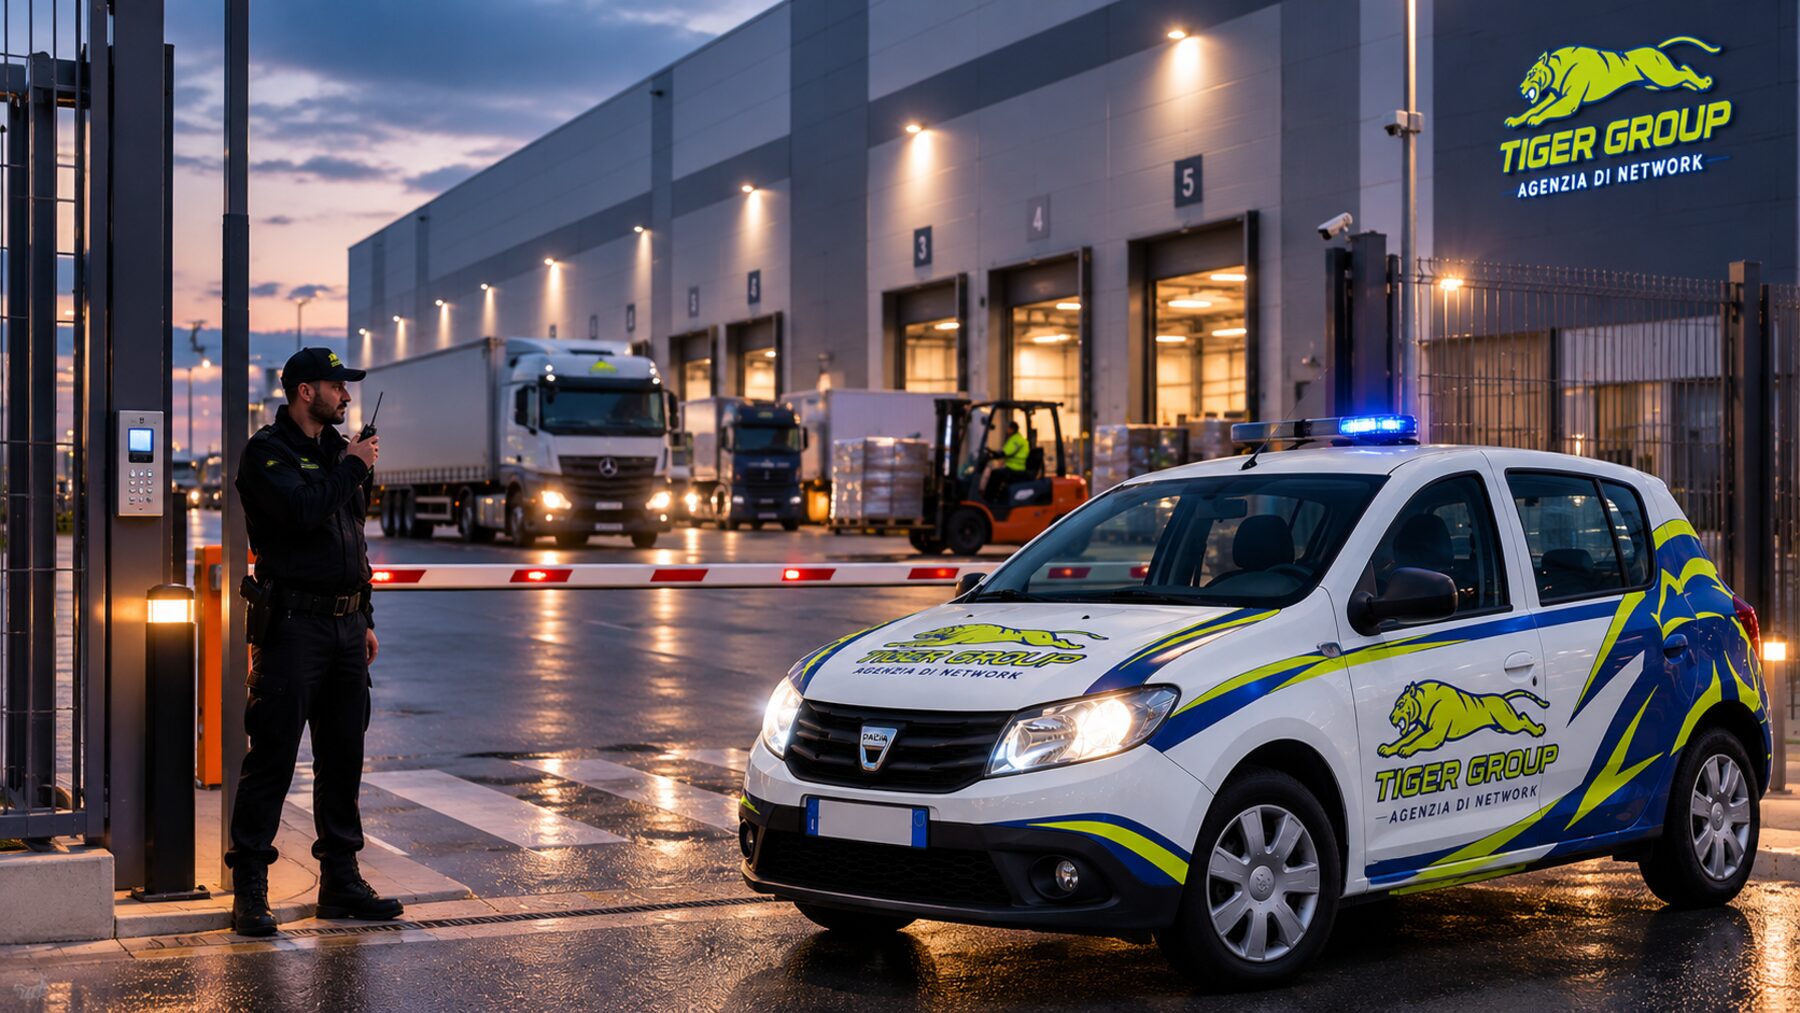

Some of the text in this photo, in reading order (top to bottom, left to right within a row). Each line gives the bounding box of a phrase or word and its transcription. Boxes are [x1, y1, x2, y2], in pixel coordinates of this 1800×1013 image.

[1500, 100, 1732, 173] TIGER GROUP
[1182, 168, 1194, 197] 5
[1517, 154, 1703, 198] AGENZIA DI NETWORK
[1032, 206, 1043, 232] 4
[918, 235, 927, 260] 3
[852, 667, 1023, 679] AGENZIA DI NETWORK
[944, 650, 1087, 668] GROUP
[1375, 744, 1559, 803] TIGER GROUP
[1389, 785, 1537, 824] AGENZIA DI NETWORK
